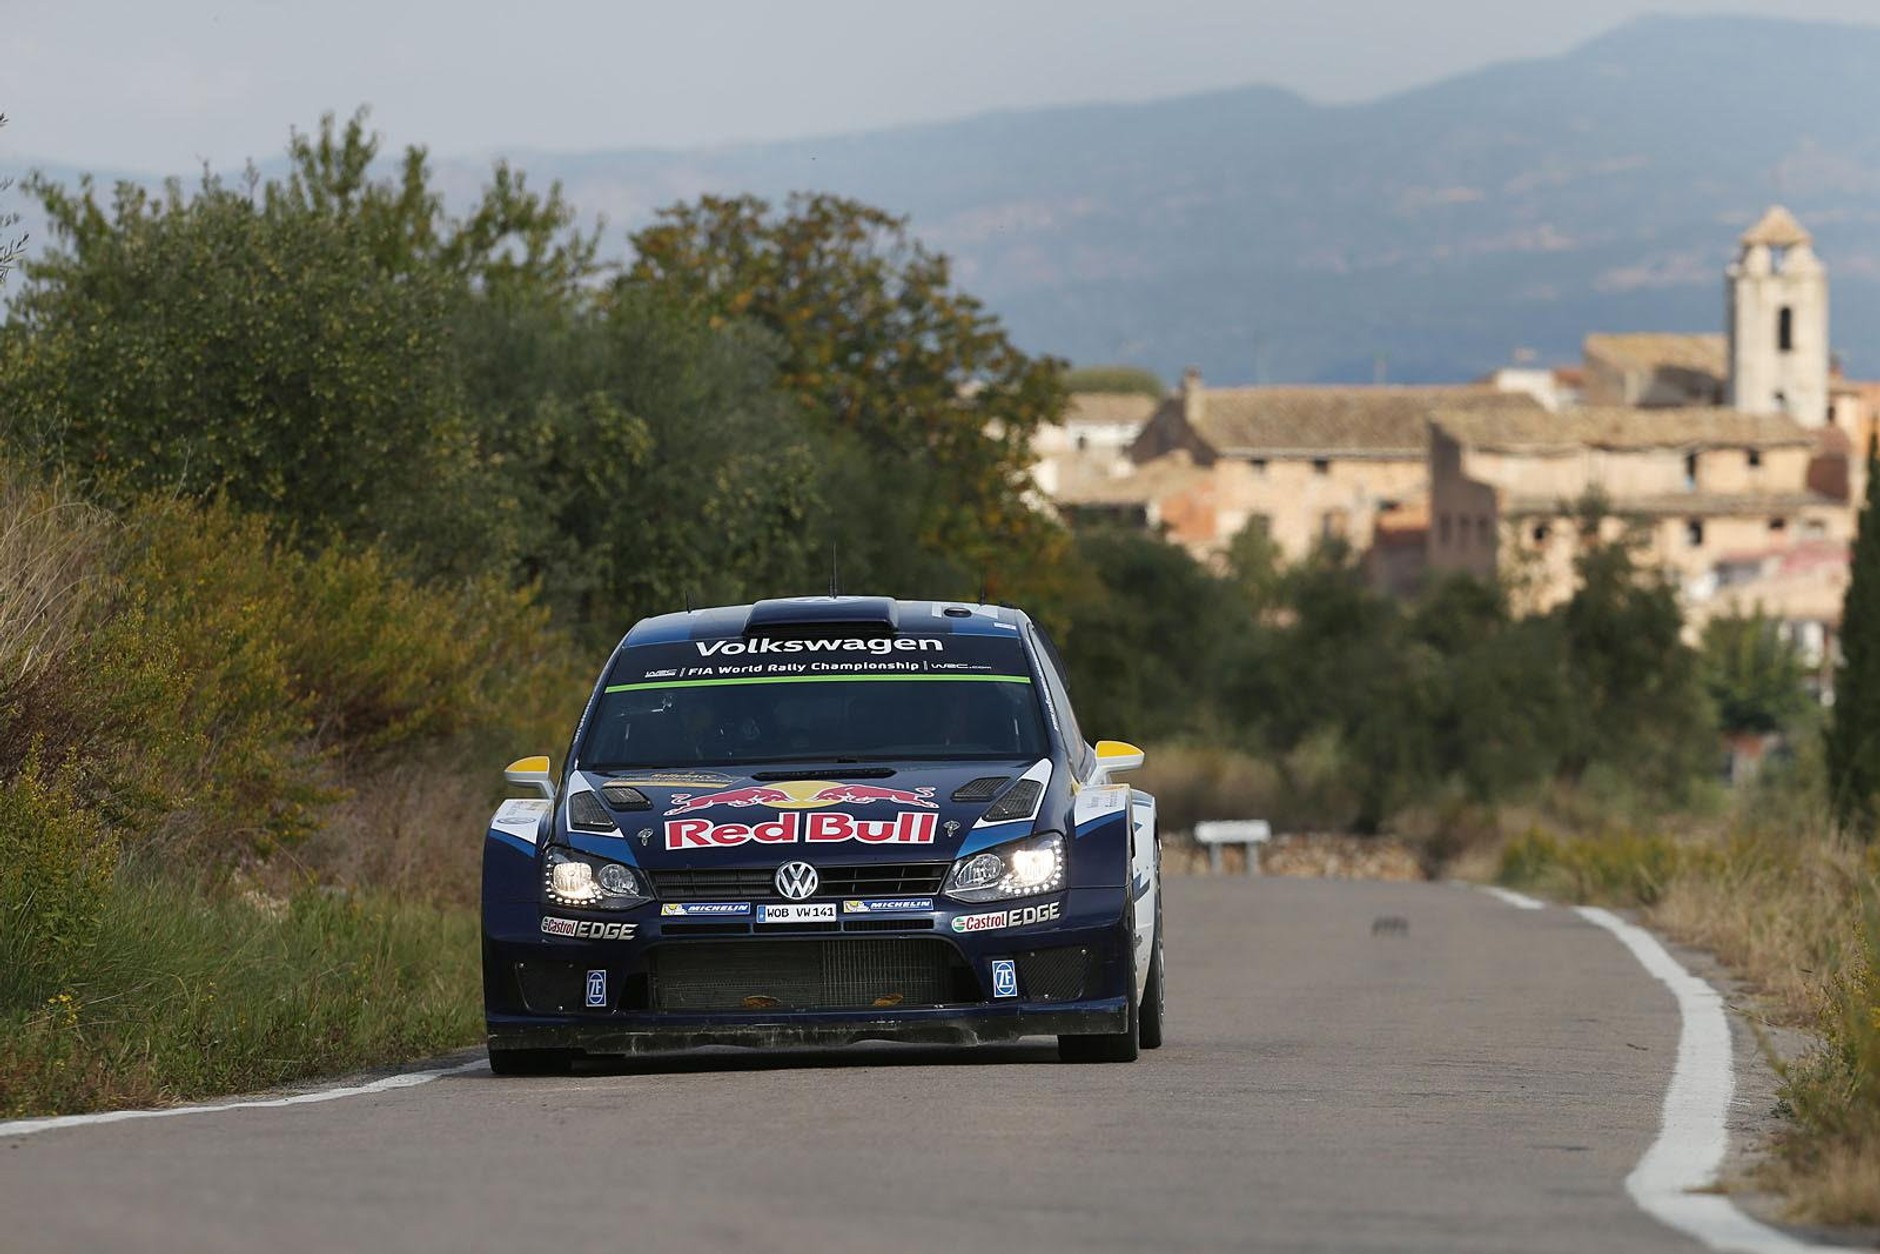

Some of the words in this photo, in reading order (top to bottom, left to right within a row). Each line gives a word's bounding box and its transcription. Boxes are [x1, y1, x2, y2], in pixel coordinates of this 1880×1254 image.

[696, 638, 944, 657] Volkswagen
[688, 666, 713, 676] FIA
[718, 664, 763, 674] World
[767, 662, 806, 672] Rally
[811, 661, 919, 671] Championship
[668, 812, 796, 848] Red
[809, 813, 934, 842] Bull
[688, 904, 749, 912] MICHELIN
[767, 908, 790, 918] WOB
[796, 908, 812, 918] VW
[813, 907, 834, 917] 141
[870, 901, 931, 909] MICHELIN
[966, 914, 1005, 930] Castrol
[1008, 902, 1060, 927] EDGE
[548, 919, 575, 935] Castrol
[576, 922, 639, 940] EDGE
